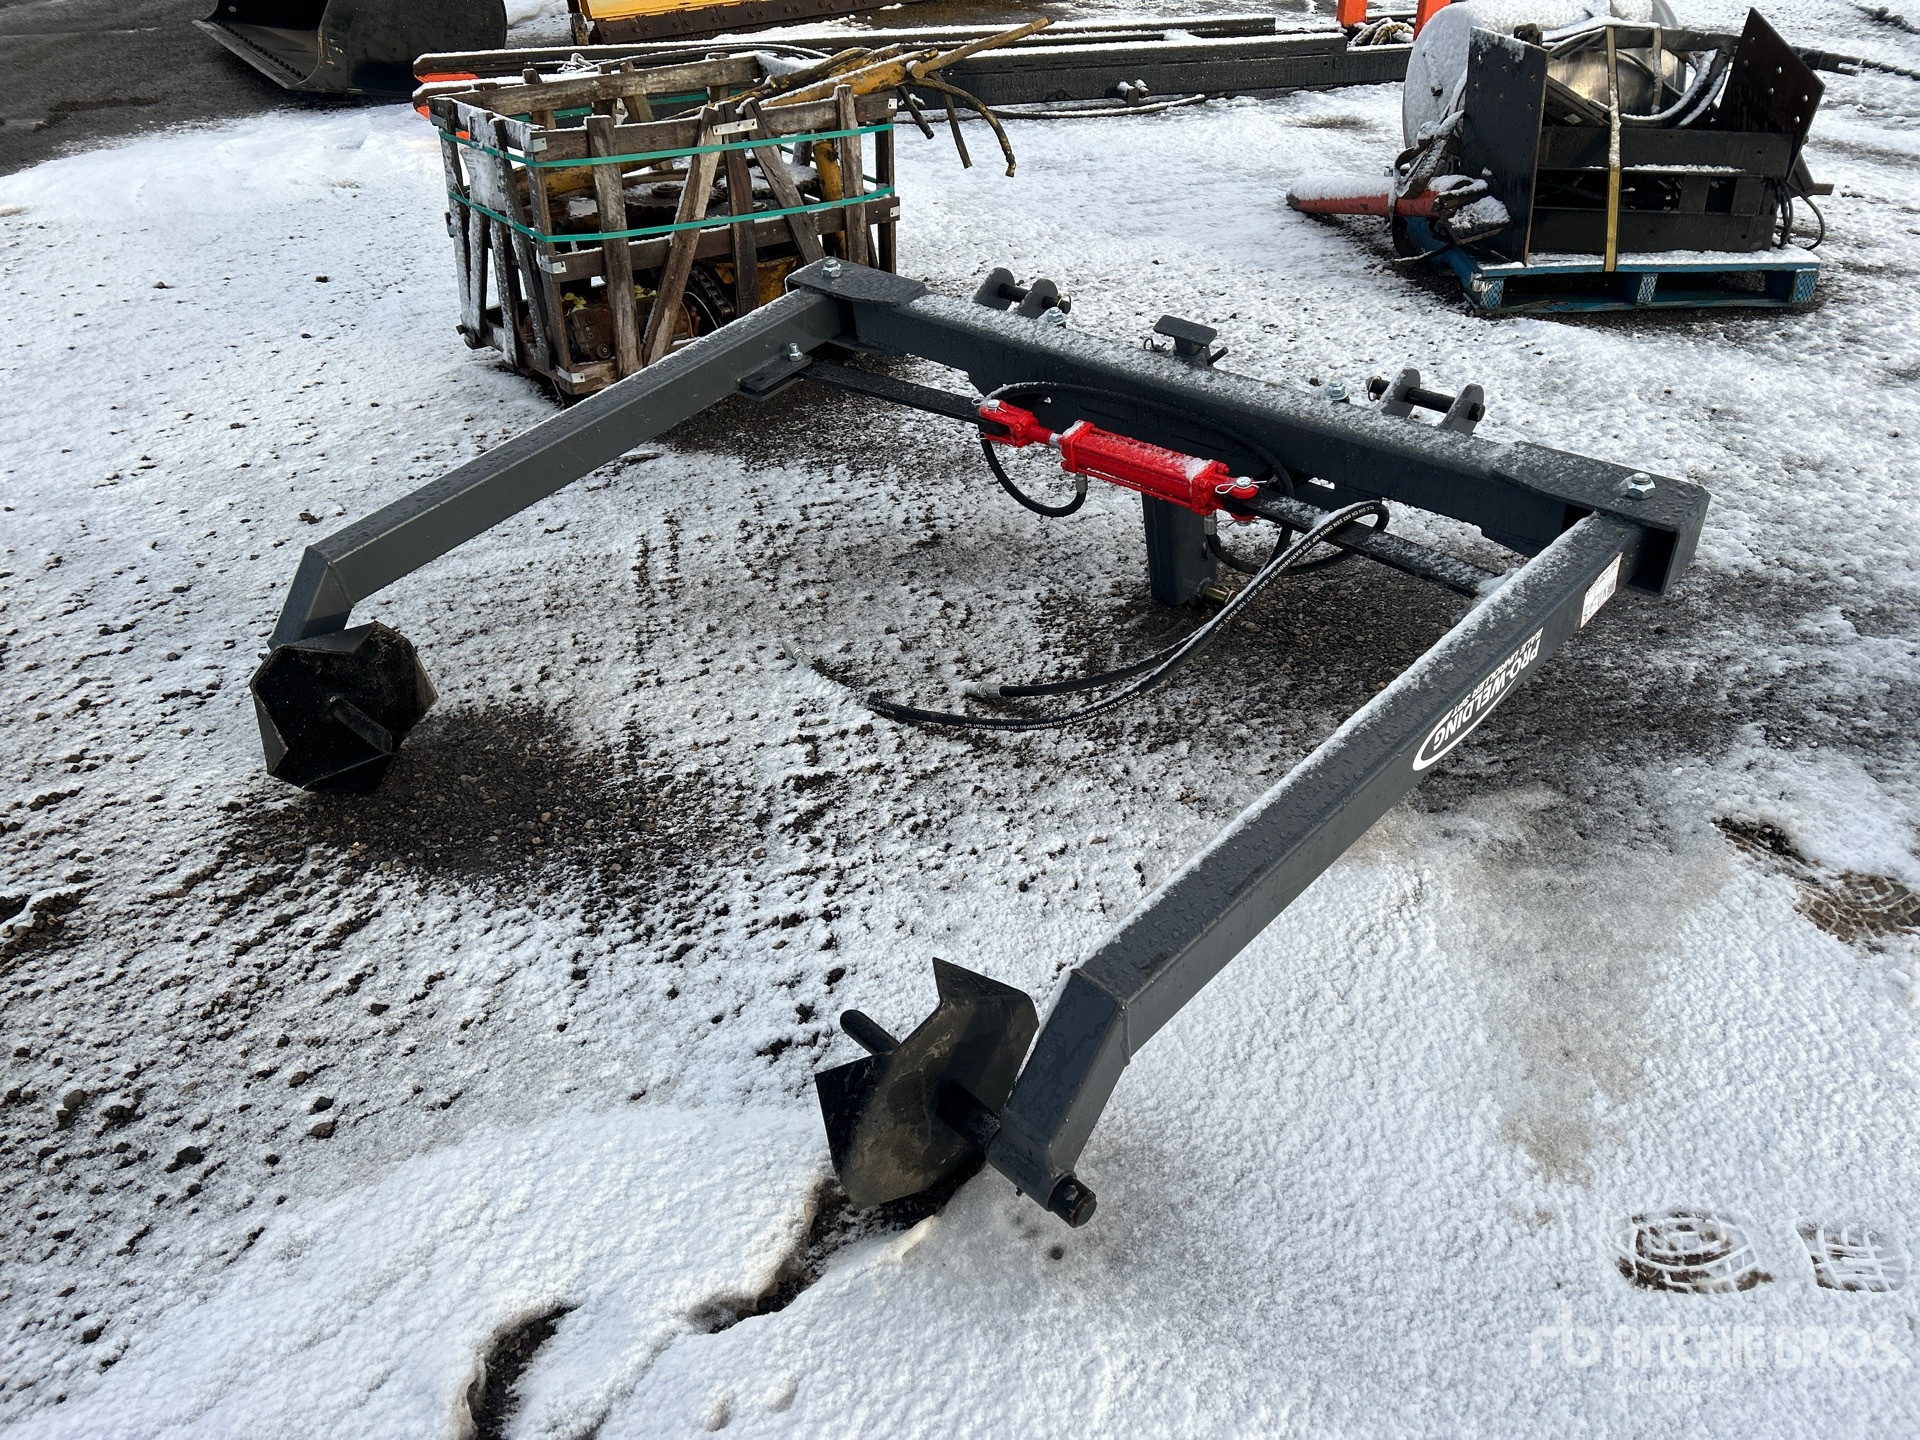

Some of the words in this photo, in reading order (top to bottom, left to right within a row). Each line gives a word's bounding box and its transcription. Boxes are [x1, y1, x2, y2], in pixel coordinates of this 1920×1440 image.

[1519, 627, 1544, 657] BALE
[1433, 638, 1542, 751] PRO-WELDING
[1471, 649, 1520, 699] UNROLLER
